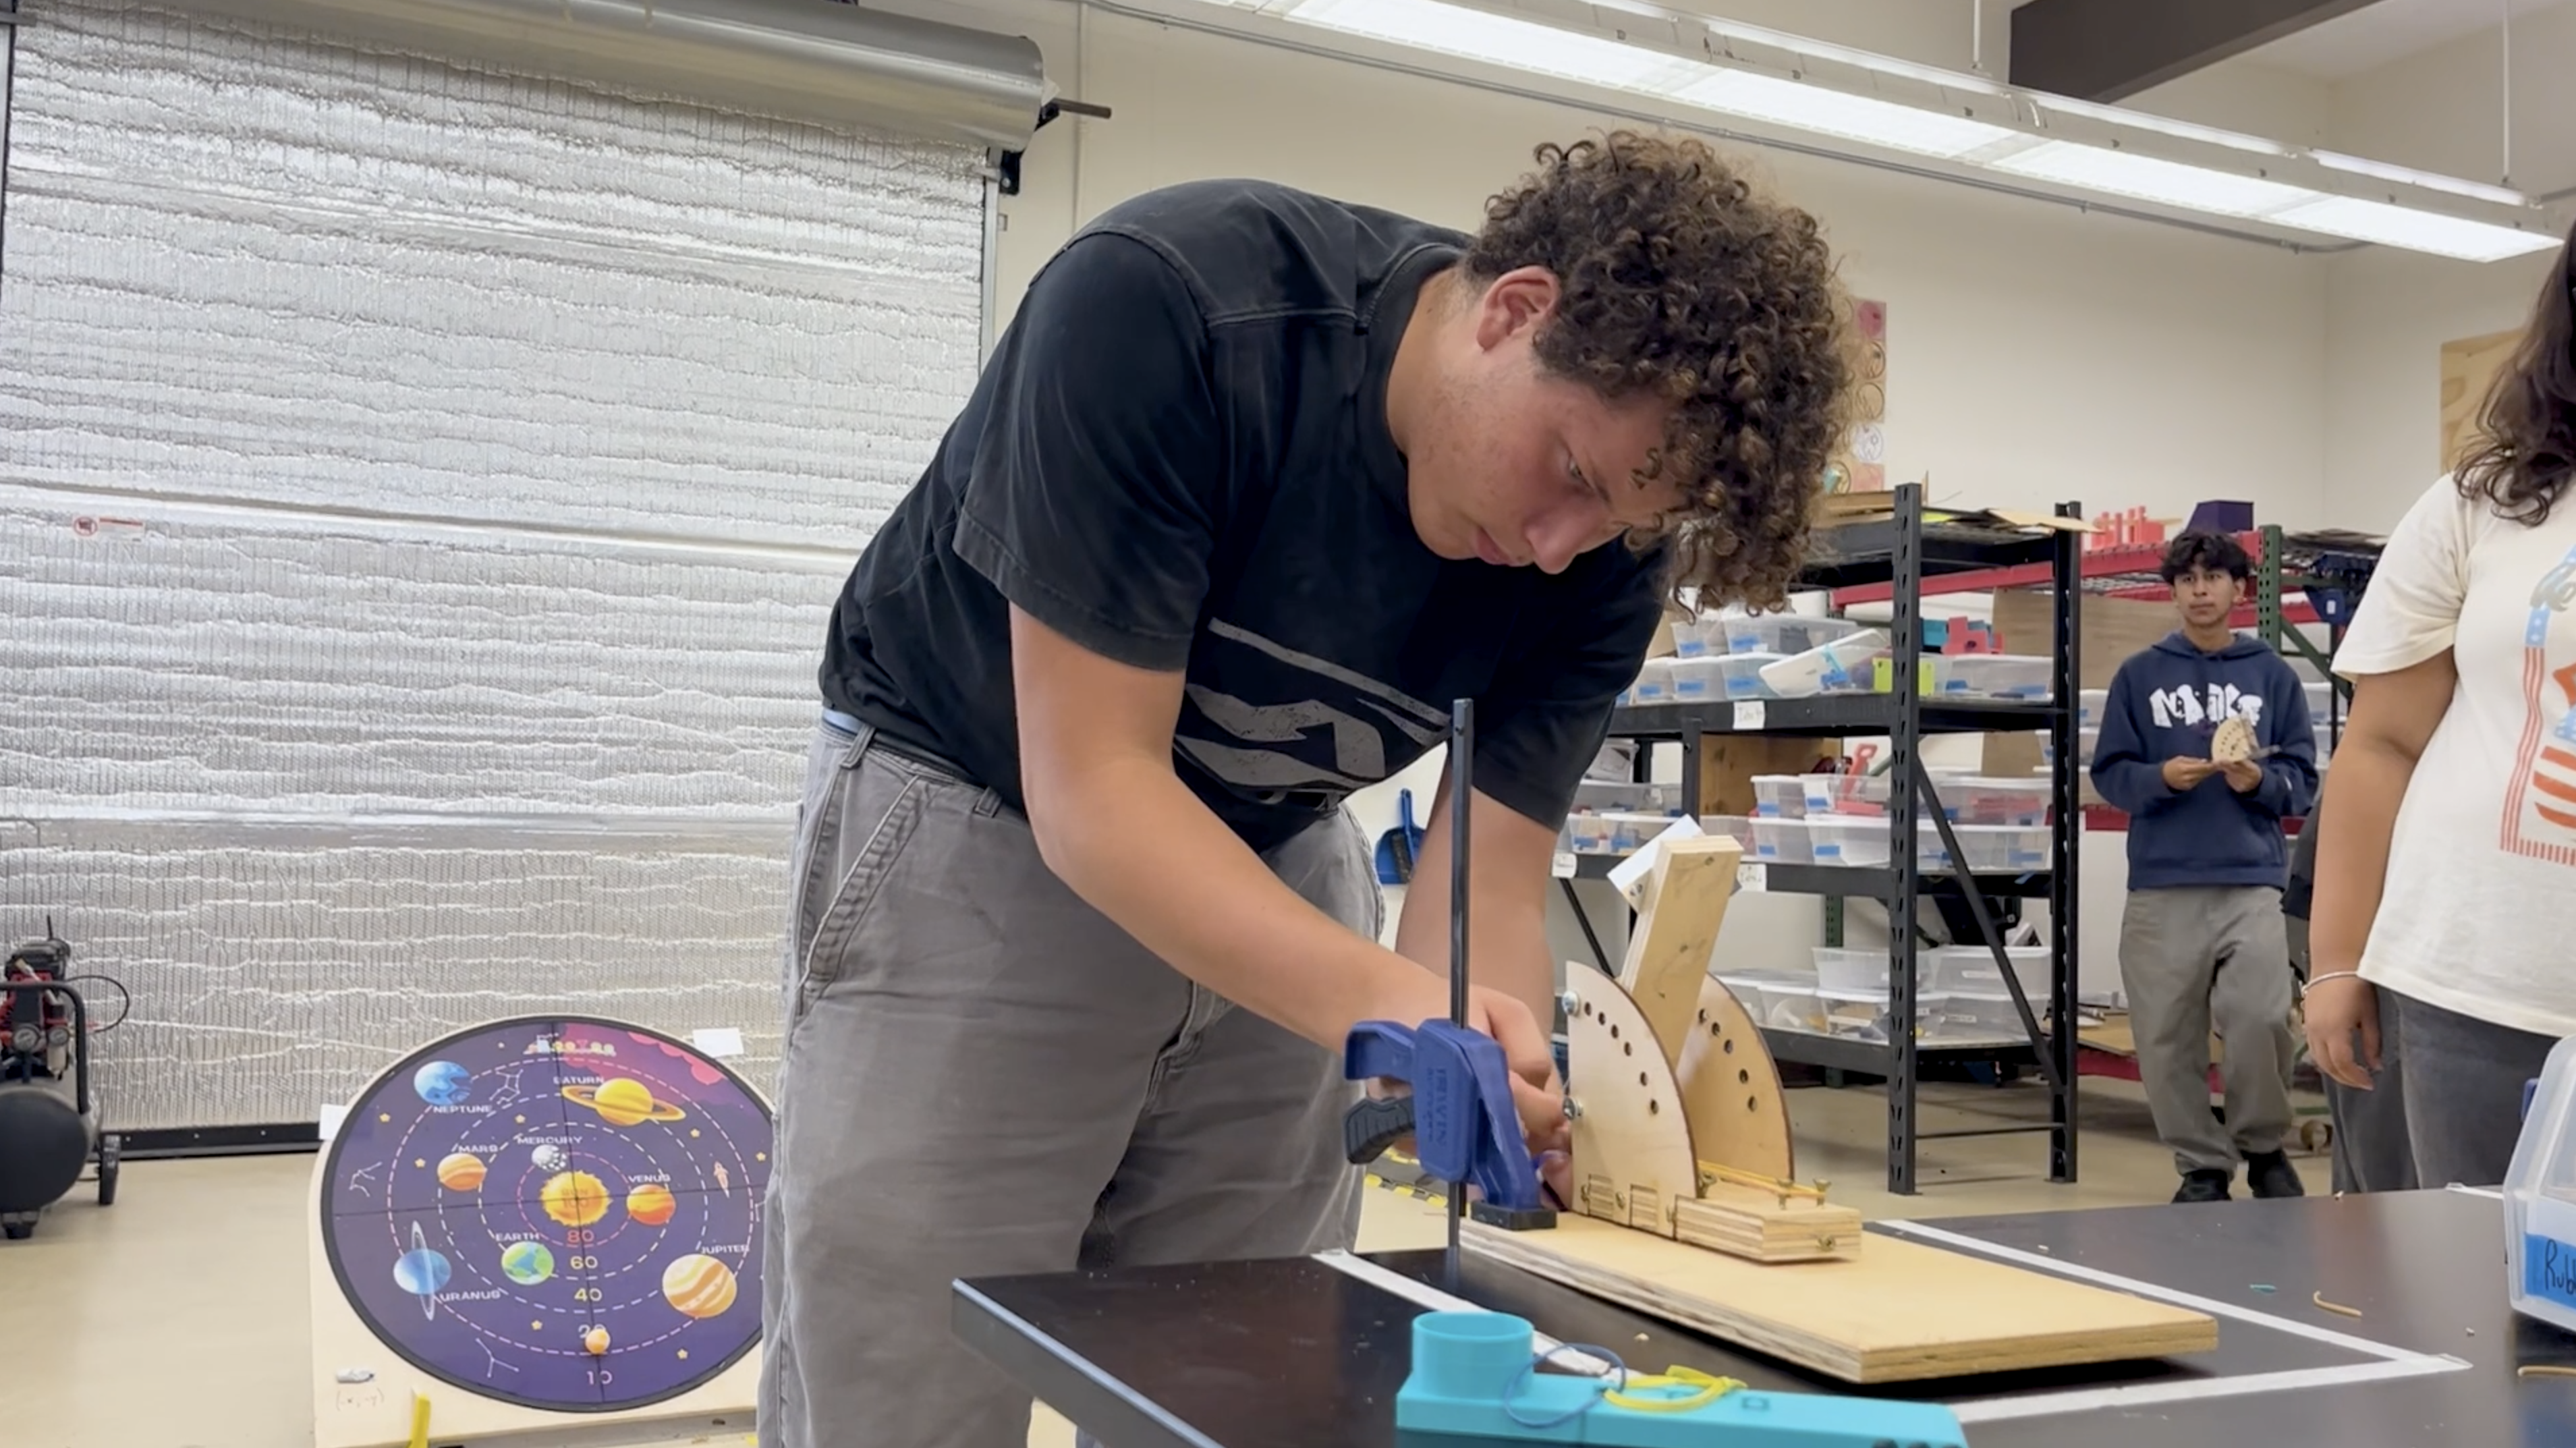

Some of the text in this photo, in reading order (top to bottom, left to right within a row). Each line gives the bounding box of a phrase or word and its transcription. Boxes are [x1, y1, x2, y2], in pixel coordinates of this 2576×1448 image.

[553, 1076, 605, 1085] SATURN
[433, 1105, 493, 1114] NEPTUNE
[516, 1136, 583, 1146] MERCURY
[458, 1144, 499, 1154] MARS
[627, 1173, 671, 1183] VENUS
[495, 1232, 540, 1242] EARTH
[567, 1229, 594, 1244] 80
[701, 1244, 750, 1254] JUPITER
[570, 1256, 598, 1270] 60
[439, 1290, 501, 1302] URANUS
[574, 1288, 603, 1302] 40
[586, 1370, 613, 1385] 10
